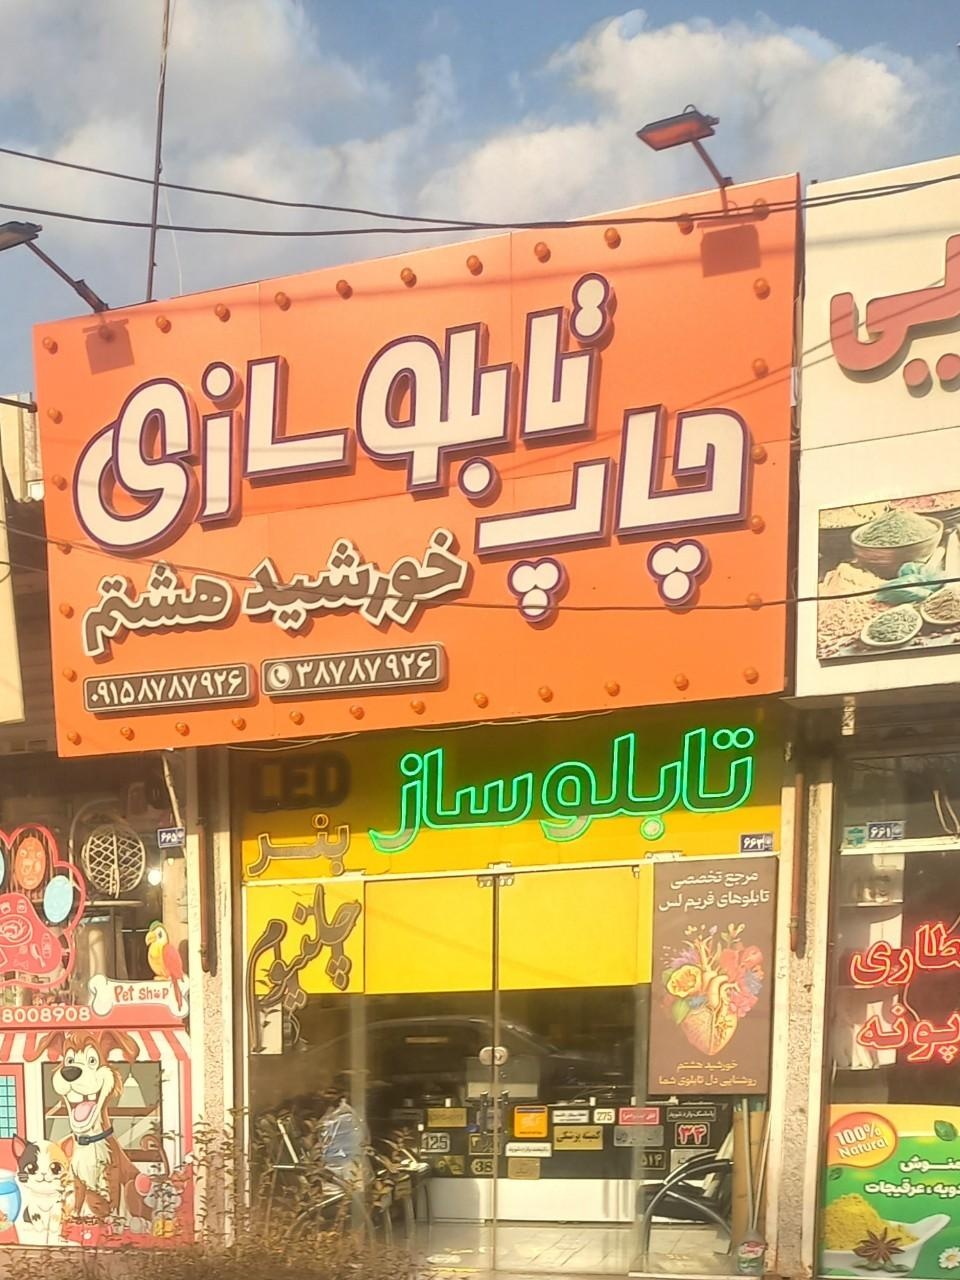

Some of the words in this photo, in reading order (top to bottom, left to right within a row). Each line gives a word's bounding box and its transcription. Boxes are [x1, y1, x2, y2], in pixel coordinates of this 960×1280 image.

[356, 271, 613, 502] تابلو
[72, 353, 352, 555] سازی
[474, 403, 755, 624] چاپ
[242, 527, 468, 632] خورشید
[82, 561, 233, 657] هشتم
[246, 813, 350, 877] بنر
[670, 870, 722, 890] تخصصی
[724, 872, 759, 887] مرجع
[683, 891, 715, 912] فریم
[716, 889, 770, 908] تابلوهای
[850, 923, 960, 985] طاری
[114, 985, 135, 1002] Pet
[836, 1121, 881, 1147] 100%
[838, 1138, 889, 1159] Natural
[864, 1179, 926, 1197] عرقیجات
